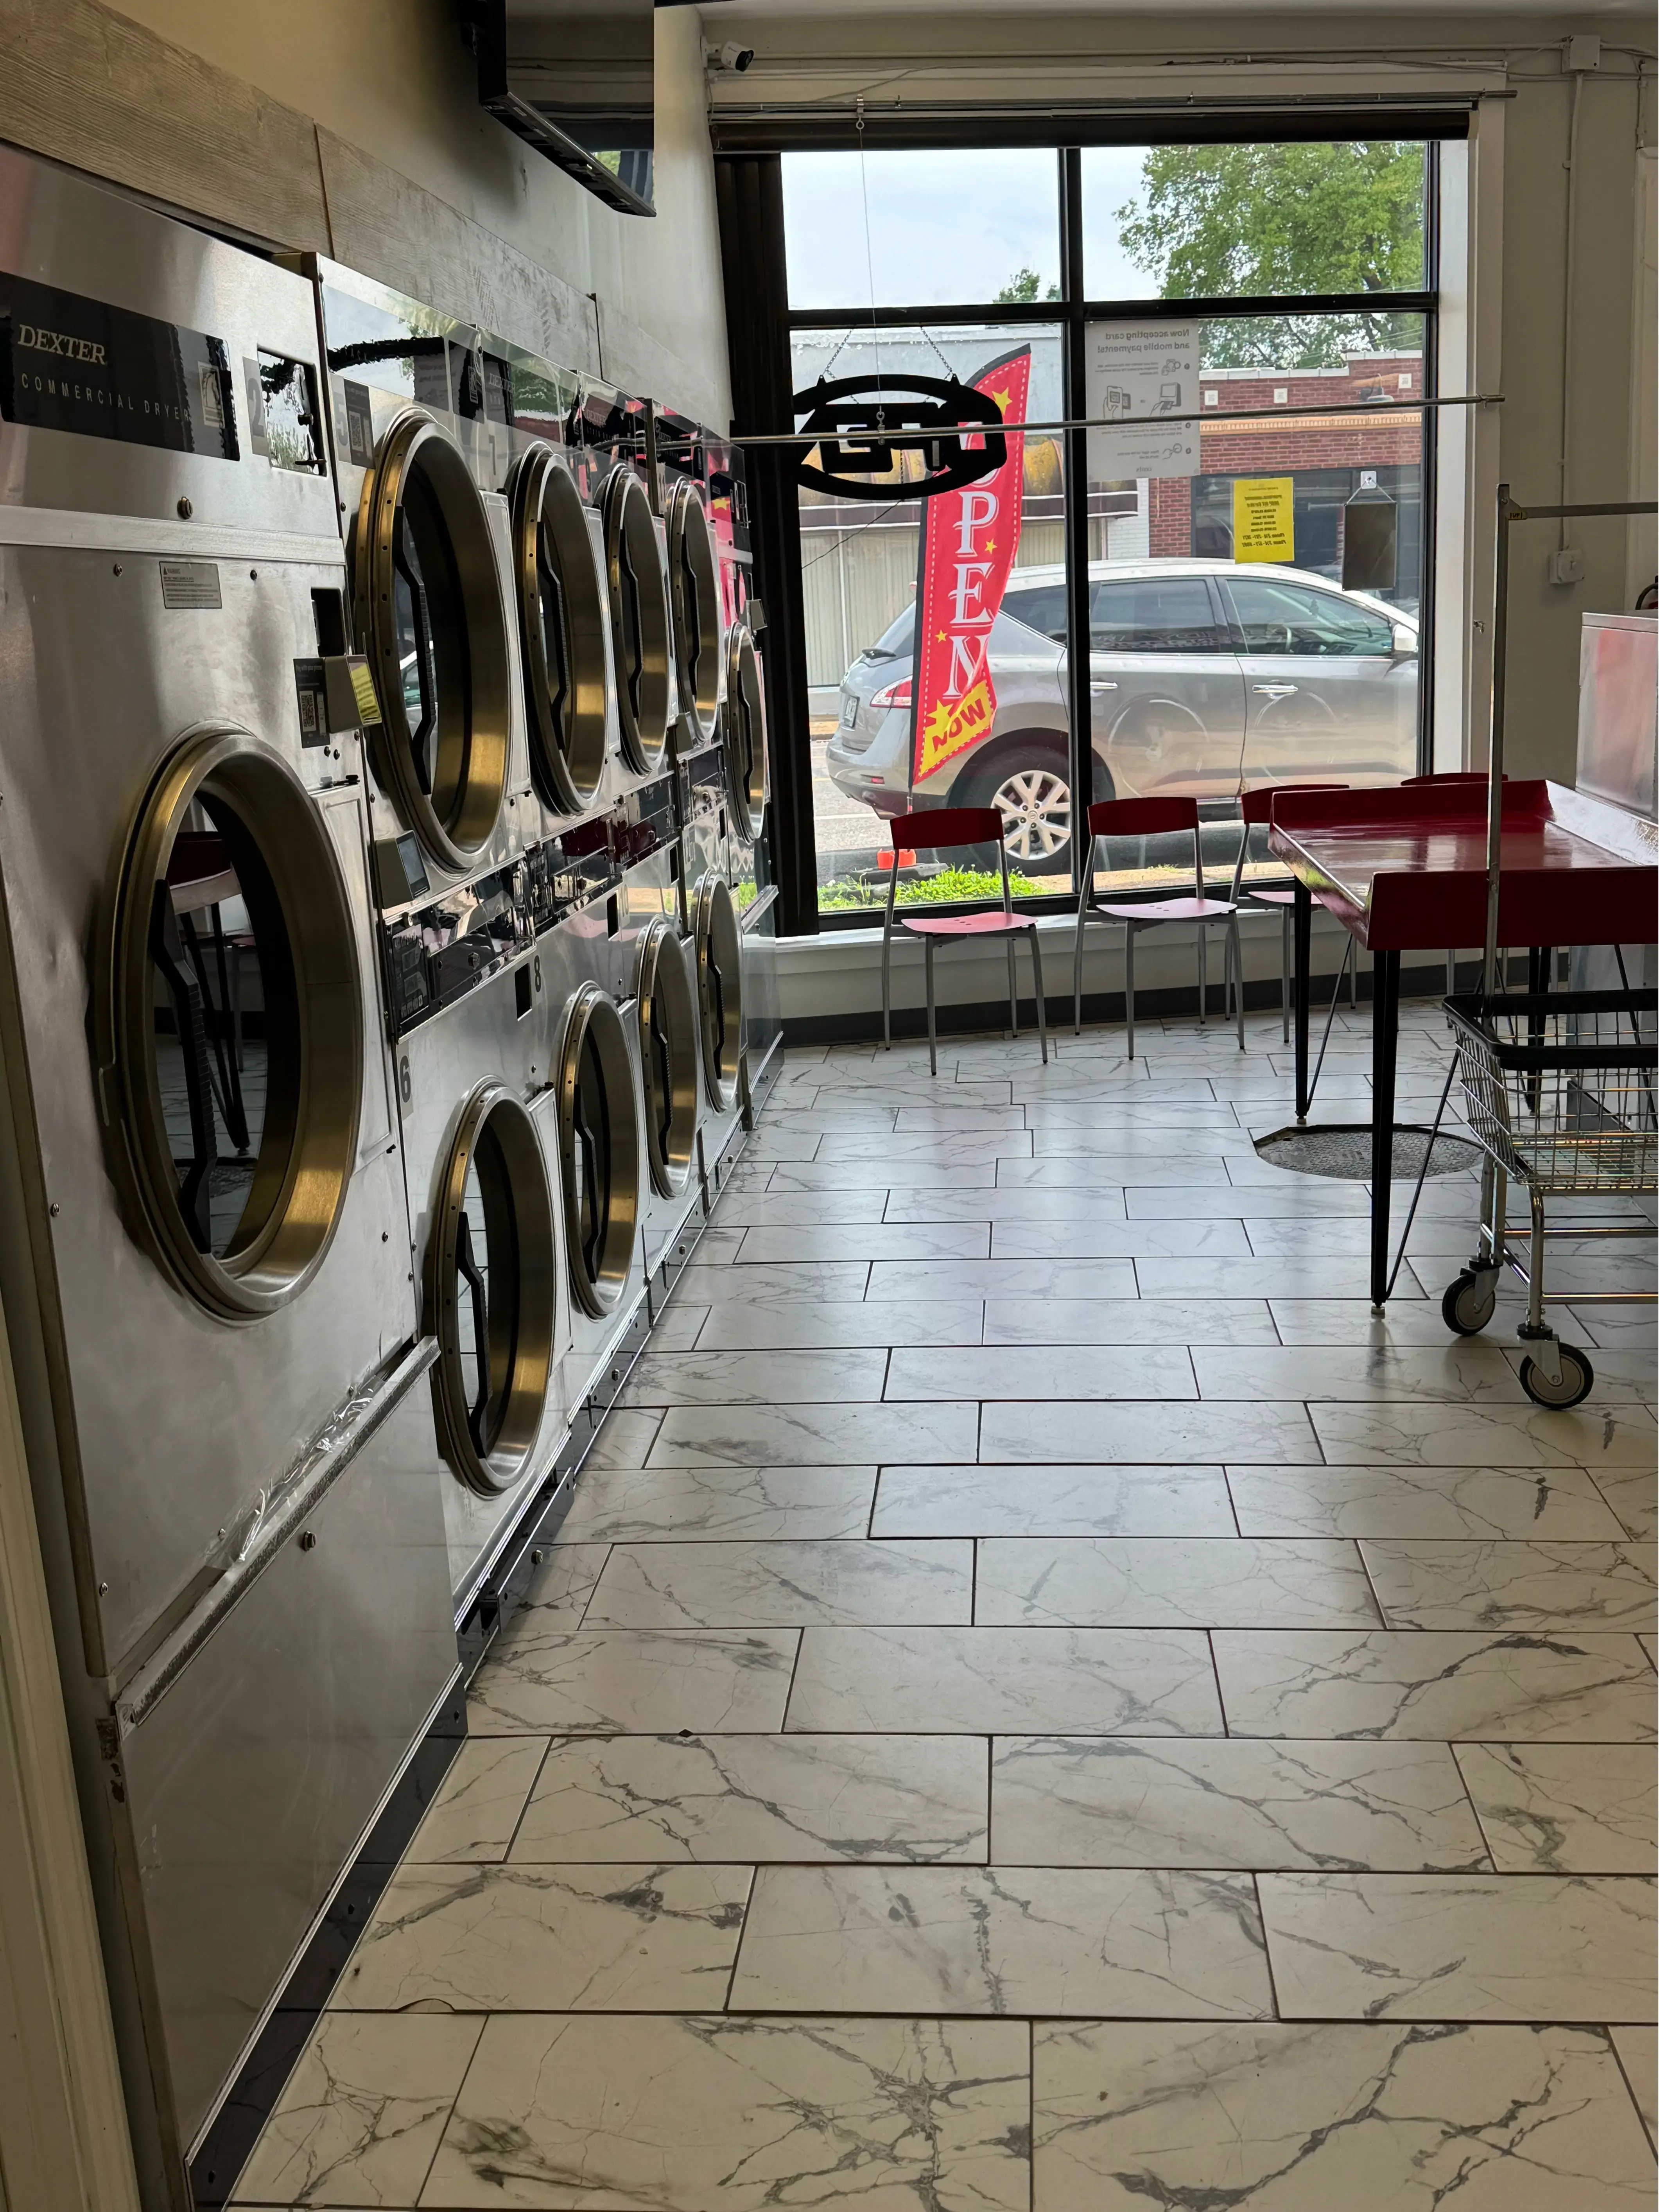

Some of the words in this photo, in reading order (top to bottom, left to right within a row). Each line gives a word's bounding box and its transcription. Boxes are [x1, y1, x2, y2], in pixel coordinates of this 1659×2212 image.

[18, 324, 106, 365] DEXTER
[22, 373, 134, 411] COMMERCIAL
[144, 400, 191, 421] DRYER
[248, 378, 265, 437] 2
[334, 391, 348, 446] 5
[932, 698, 986, 753] NOW
[534, 955, 541, 992] 8
[400, 1055, 411, 1103] 6
